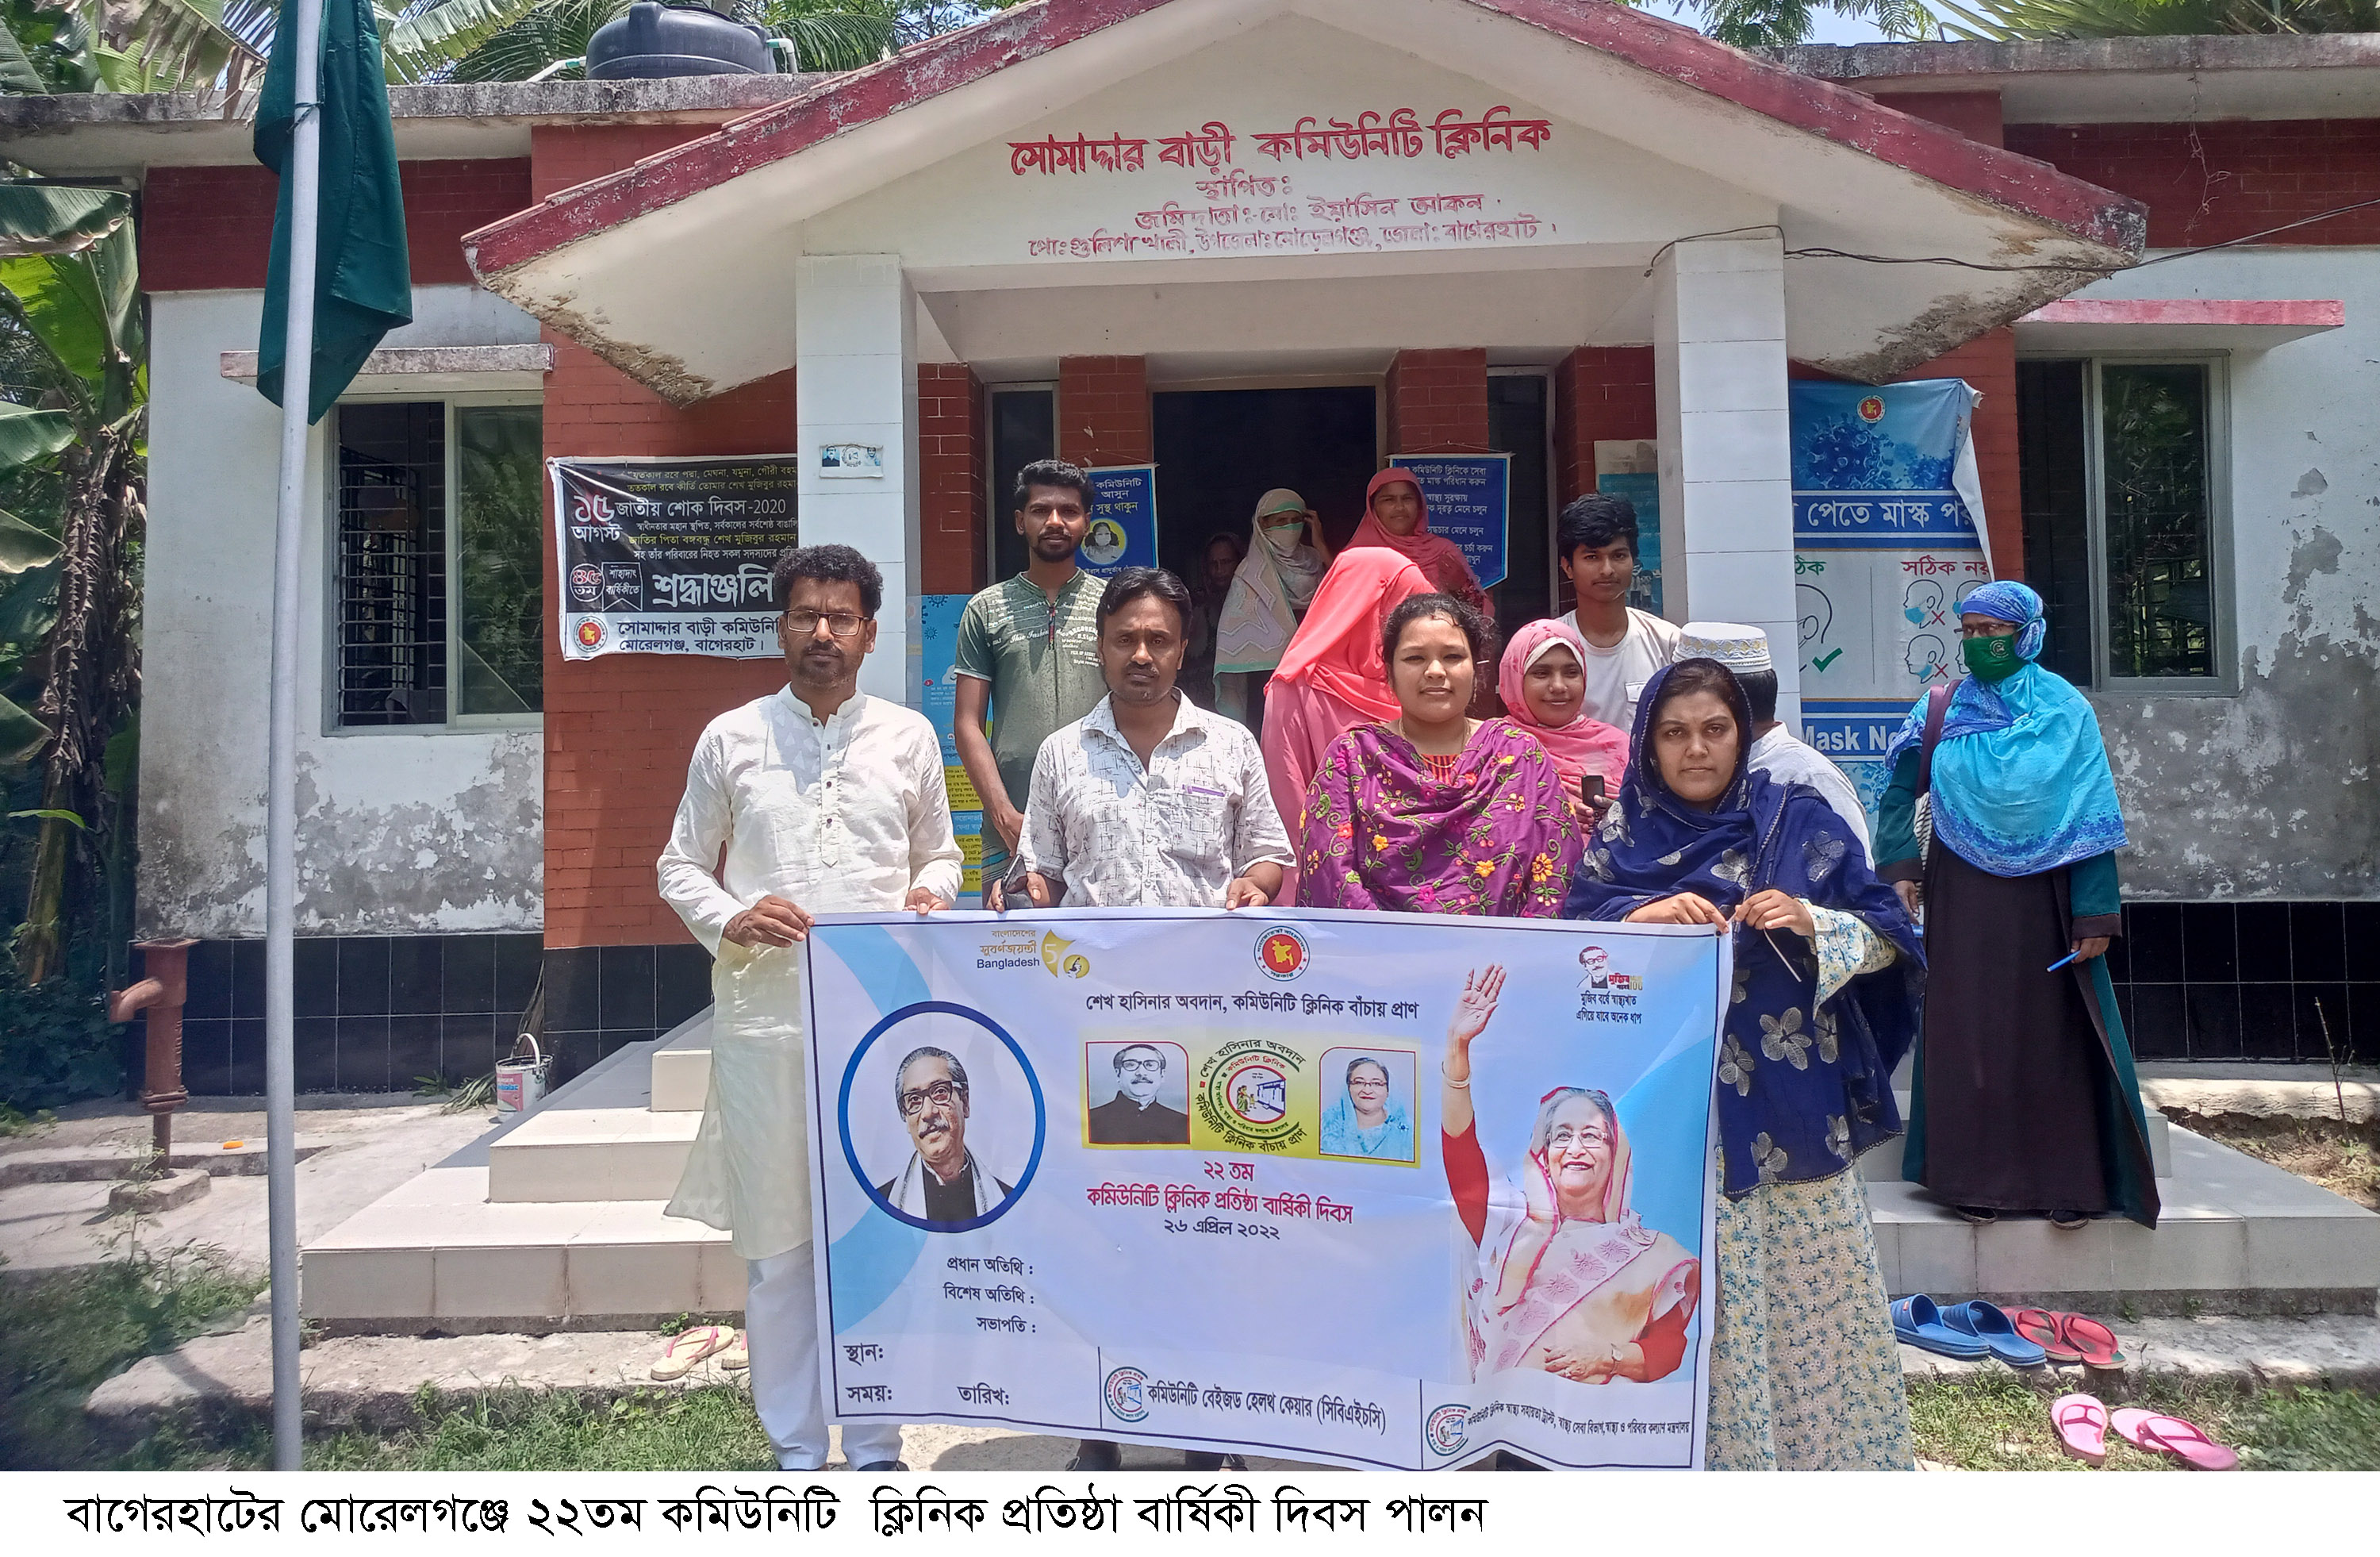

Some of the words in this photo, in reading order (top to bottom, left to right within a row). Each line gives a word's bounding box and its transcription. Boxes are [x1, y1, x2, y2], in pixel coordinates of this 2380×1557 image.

[1008, 132, 1149, 175] সোমাদ্দার
[1154, 121, 1237, 175] বাড়ী
[1250, 108, 1423, 161] কমিউনিটি
[1426, 106, 1553, 159] ক্লিনিক
[1307, 192, 1399, 222] ইয়াসিন
[1407, 194, 1484, 214] আকন
[731, 467, 754, 477] যমুনা,
[677, 480, 697, 491] কীর্তি
[698, 481, 726, 490] তোমার
[728, 480, 745, 490] শেখ
[747, 479, 774, 490] মুজিবুর
[1095, 478, 1142, 489] কমিউনিটি
[1101, 490, 1129, 499] আসুন
[615, 497, 662, 517] জাতীয়
[667, 499, 704, 517] শোক
[1114, 502, 1138, 513] থাকুন
[1807, 500, 1873, 527] পেতে
[1879, 499, 1933, 528] মাস্ক
[570, 521, 623, 543] আগস্ট
[714, 518, 747, 530] সর্বকালের
[628, 533, 657, 545] জাতির
[659, 533, 679, 544] পিতা
[682, 535, 710, 547] বঙ্গবন্ধু
[714, 534, 731, 544] শেখ
[735, 532, 765, 545] মুজিবুর
[768, 533, 797, 544] রহমান
[633, 550, 647, 560] সহ
[648, 548, 663, 559] তাঁর
[665, 548, 699, 559] পরিবারের
[700, 547, 720, 560] নিহত
[722, 548, 741, 559] সকল
[743, 548, 777, 559] সদস্যদের
[1901, 555, 1957, 576] সঠিক
[574, 586, 597, 595] তম
[652, 563, 775, 608] শ্রদ্ধাঞ্জলি
[618, 619, 682, 635] সোমাদ্দার
[687, 617, 716, 638] বাড়ী
[620, 637, 689, 652] মোরেলগঞ্জ,
[696, 636, 755, 652] বাগেরহাট
[979, 940, 1037, 956] সুবর্ণজয়ন্তী
[977, 958, 1040, 970] Bangladesh
[1086, 994, 1115, 1009] শেখ
[1118, 991, 1172, 1012] হাসিনার
[1176, 994, 1227, 1013] অবদান,
[1231, 990, 1297, 1013] কমিউনিটি
[1300, 994, 1345, 1015] ক্লিনিক
[1348, 995, 1388, 1018] বাঁচায়
[1392, 1001, 1419, 1019] প্রাণ
[1200, 1056, 1218, 1078] শেখ
[1215, 1039, 1262, 1057] হাসিনার
[1266, 1040, 1306, 1065] অবদান
[1196, 1092, 1225, 1133] কমিউনিটি
[1223, 1130, 1256, 1151] ক্লিনিক
[1257, 1140, 1287, 1152] বাঁচায়
[1288, 1128, 1307, 1145] প্রাণ
[1203, 1160, 1225, 1181] ২২
[1229, 1162, 1254, 1182] তম
[1087, 1182, 1160, 1207] কমিউনিটি
[1164, 1184, 1211, 1213] ক্লিনিক
[1215, 1186, 1258, 1213] প্রতিষ্ঠা
[1262, 1192, 1311, 1218] বার্ষিকী
[1315, 1196, 1353, 1224] দিবস
[1164, 1219, 1188, 1233] ২৬
[1193, 1216, 1232, 1236] এপ্রিল
[1238, 1223, 1280, 1240] ২০২২
[947, 1256, 981, 1273] প্রধান
[984, 1255, 1023, 1276] অতিথি
[943, 1282, 981, 1301] বিশেষ
[985, 1284, 1024, 1304] অতিথি
[977, 1315, 1027, 1333] সভাপতি
[1146, 1380, 1199, 1406] কমিউনিটি
[1202, 1384, 1242, 1411] বেইজড
[1246, 1392, 1276, 1414] হেলথ
[1280, 1395, 1313, 1418] কেয়ার
[1317, 1394, 1386, 1435] (সিবিএইচসি)
